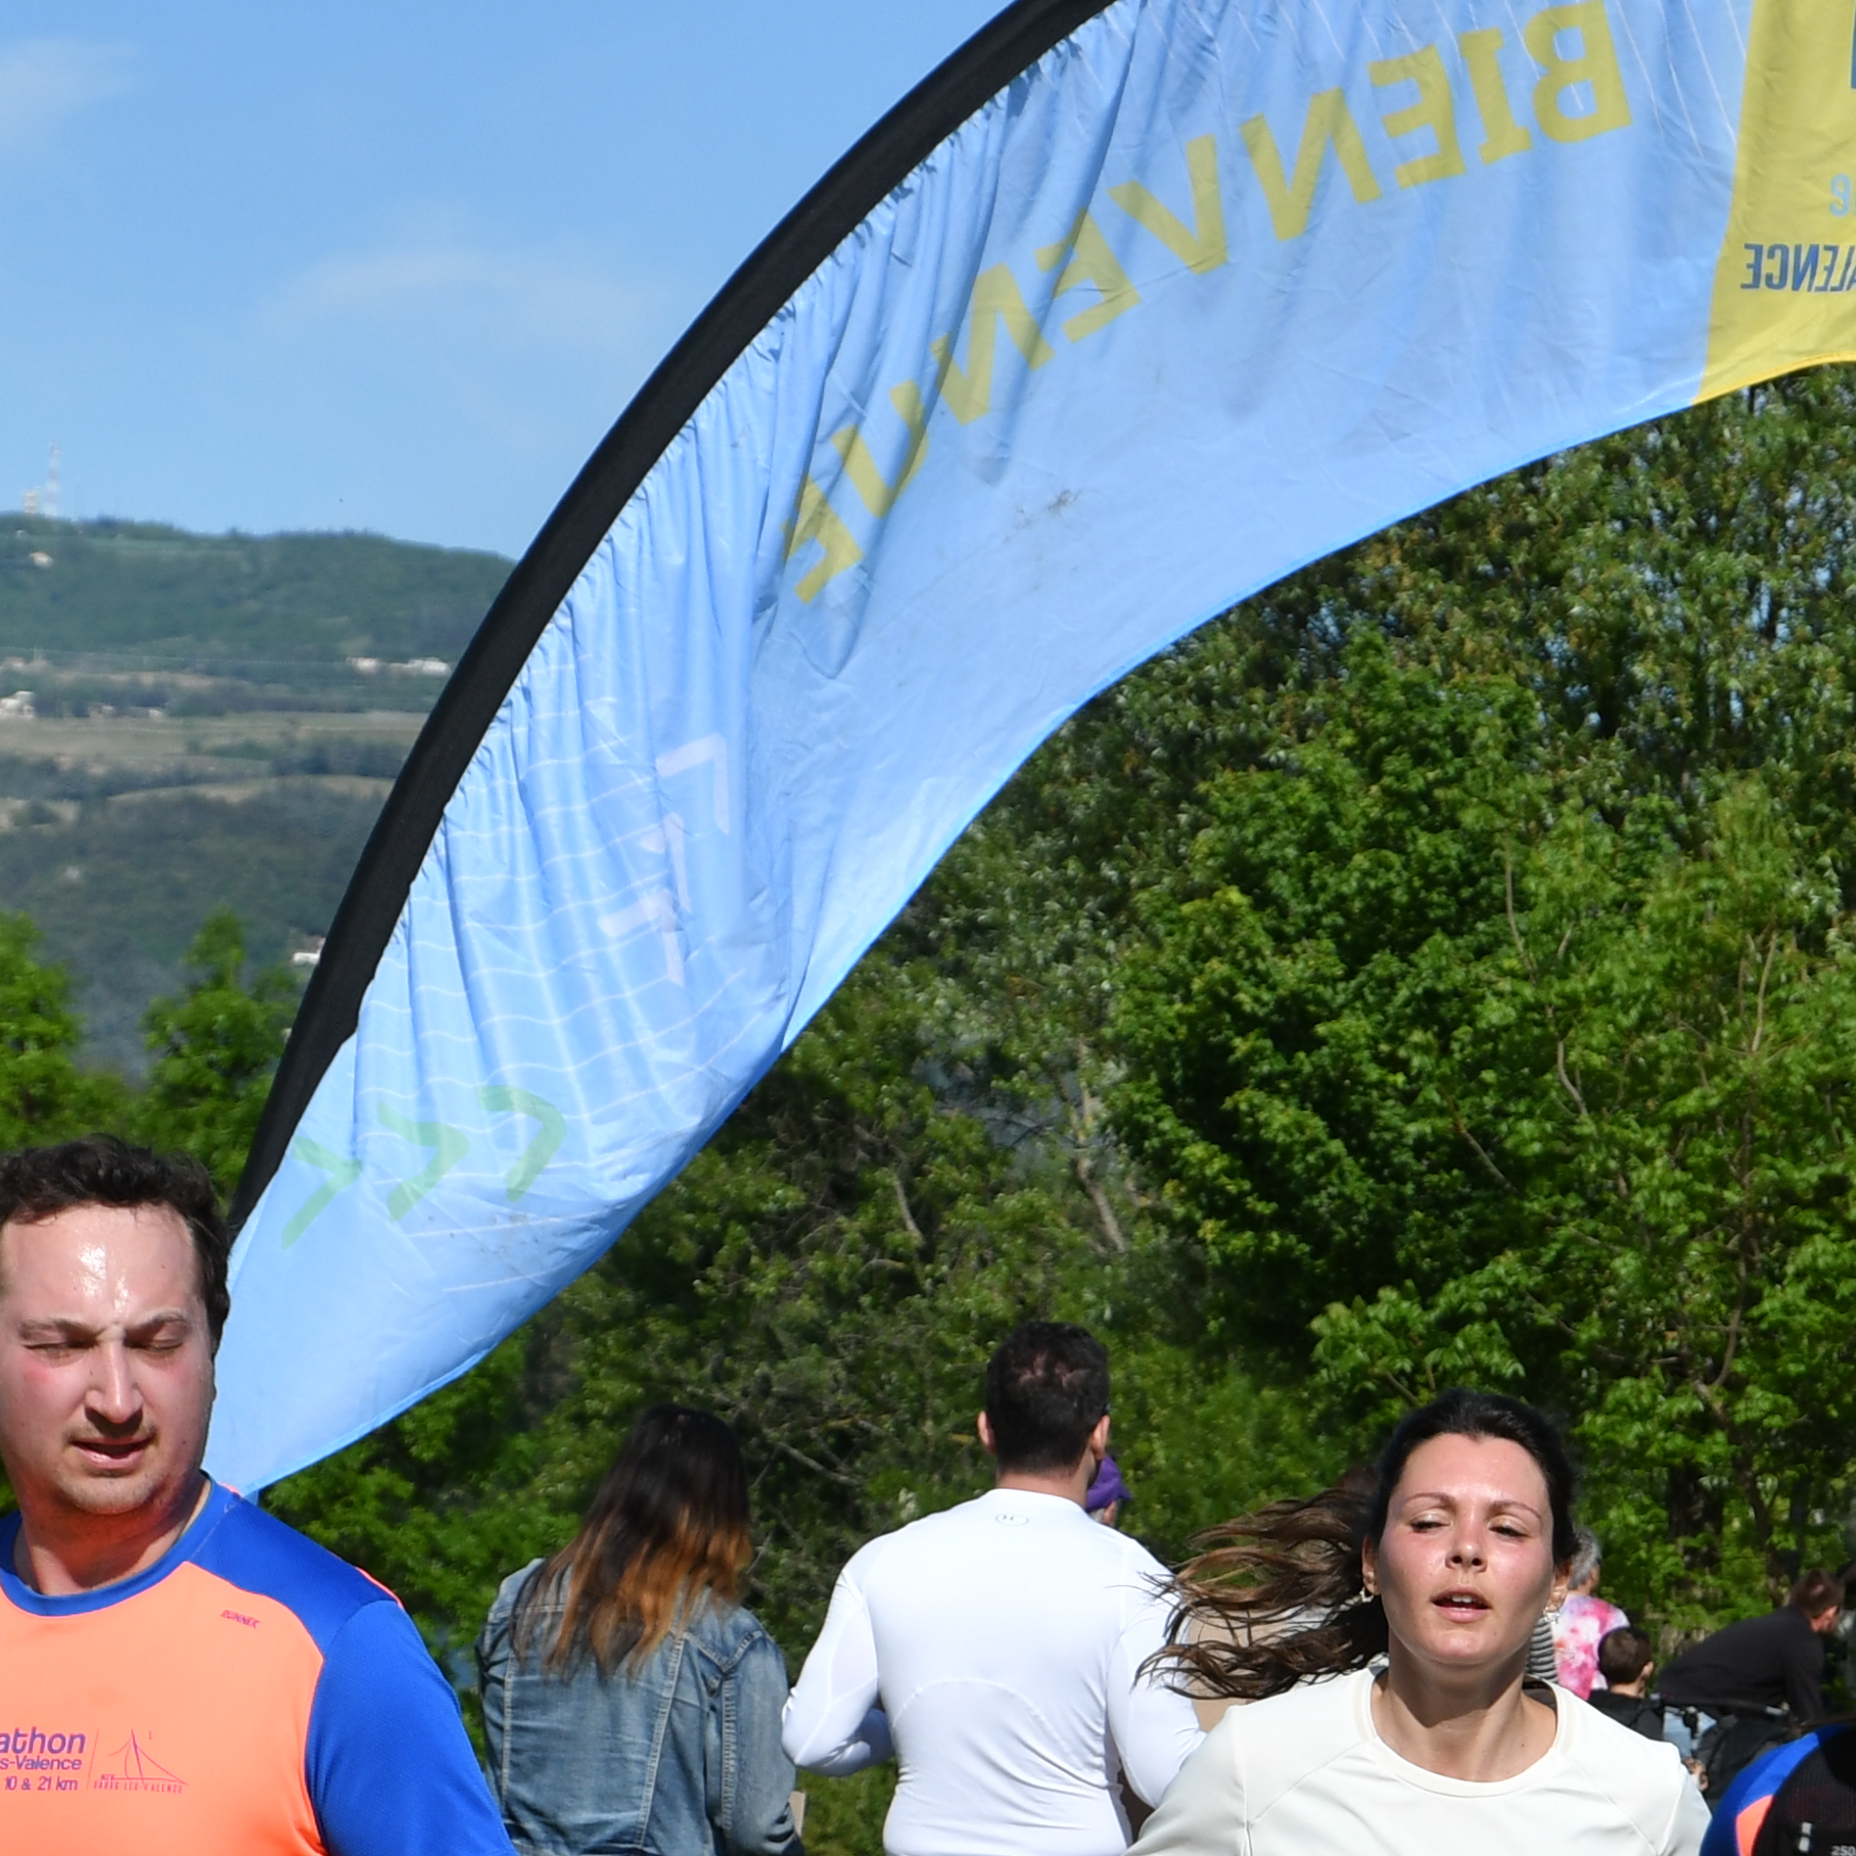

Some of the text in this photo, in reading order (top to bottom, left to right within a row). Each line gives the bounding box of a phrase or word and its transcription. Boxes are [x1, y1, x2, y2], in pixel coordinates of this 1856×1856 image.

[4, 1776, 18, 1791] 10
[21, 1777, 32, 1791] &
[37, 1776, 52, 1791] 21
[55, 1775, 79, 1791] km
